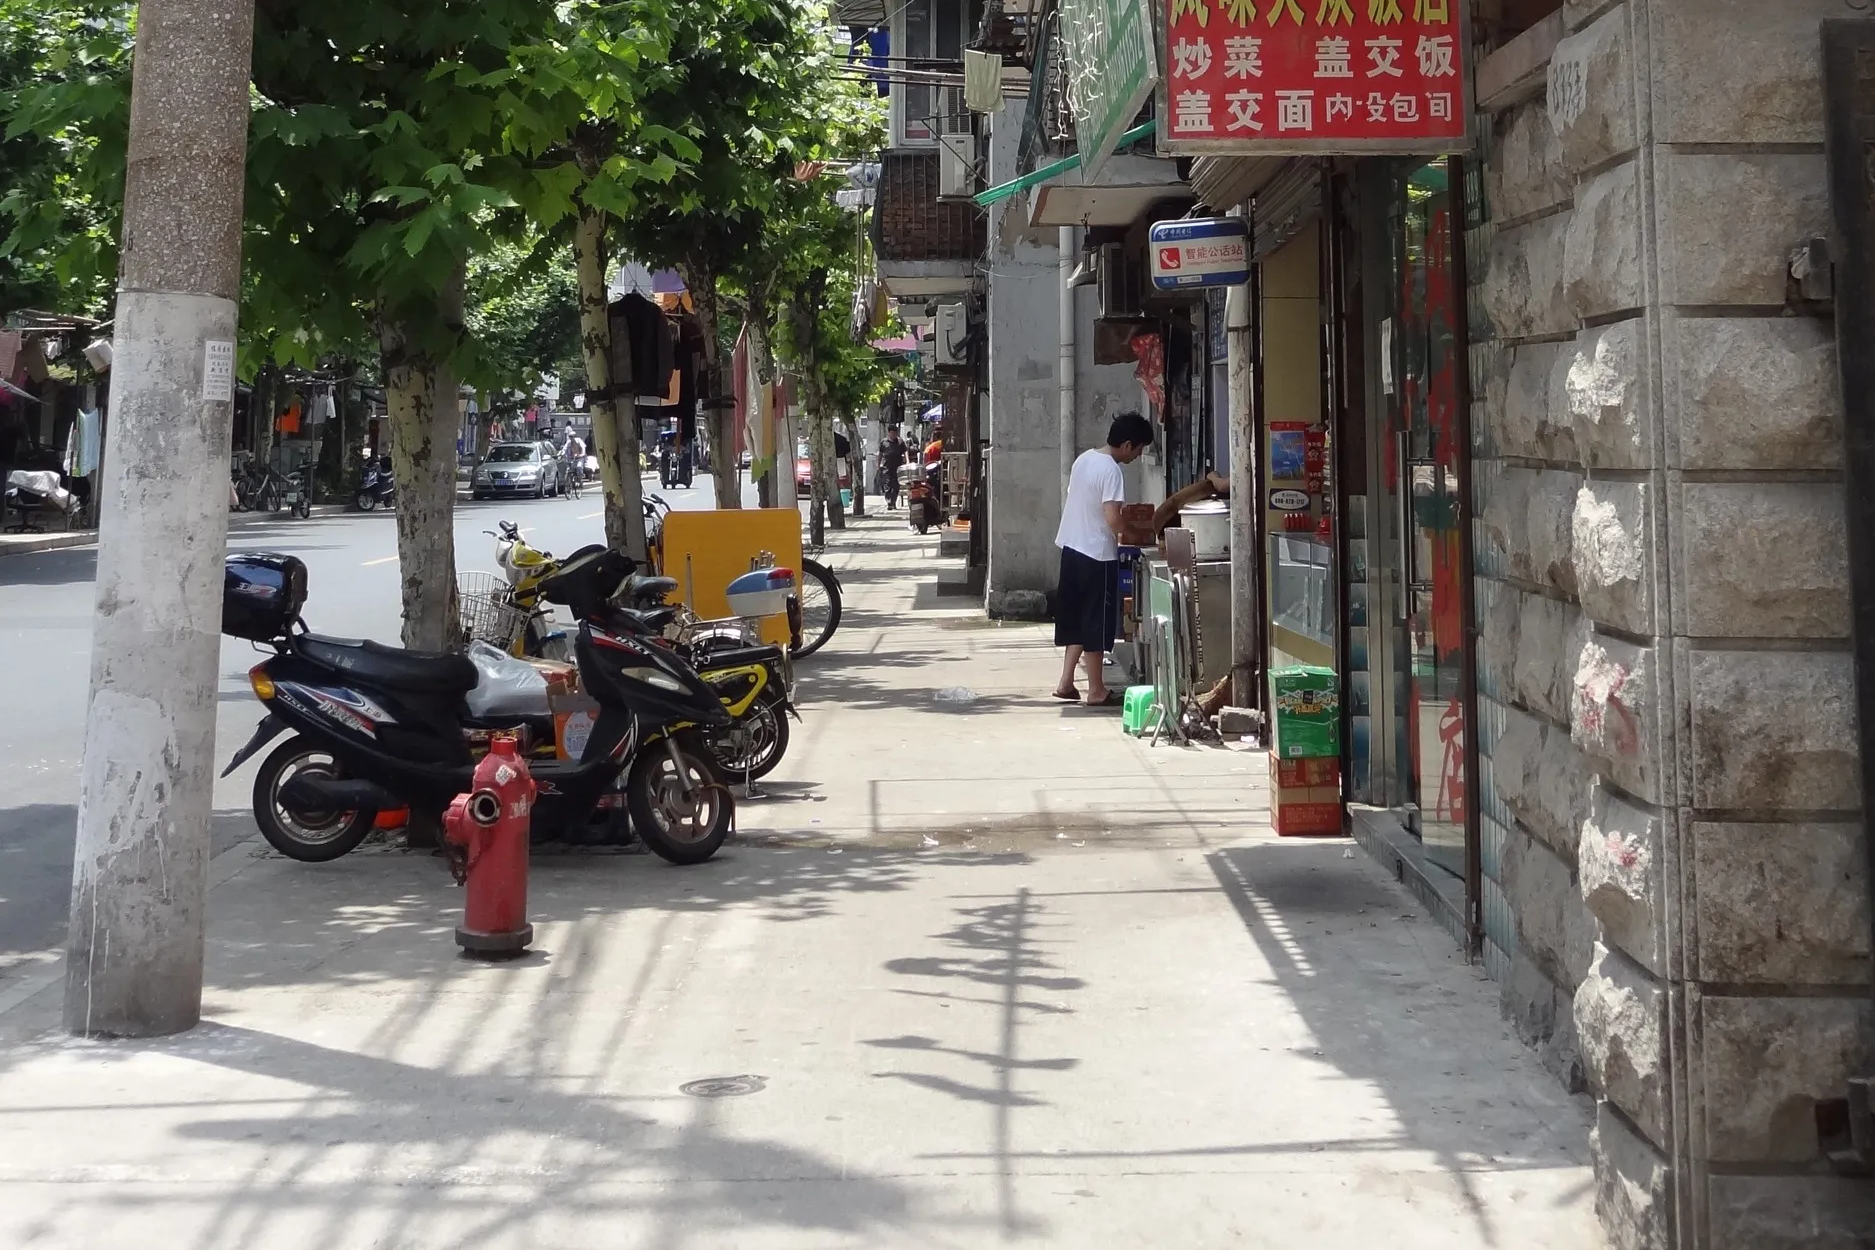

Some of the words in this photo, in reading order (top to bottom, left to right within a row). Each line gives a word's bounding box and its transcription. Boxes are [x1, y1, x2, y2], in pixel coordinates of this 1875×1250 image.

[1173, 35, 1263, 80] 炒菜
[1313, 34, 1456, 79] 盖交饭
[1174, 88, 1314, 132] 盖交面
[1185, 244, 1243, 260] 智能公话站
